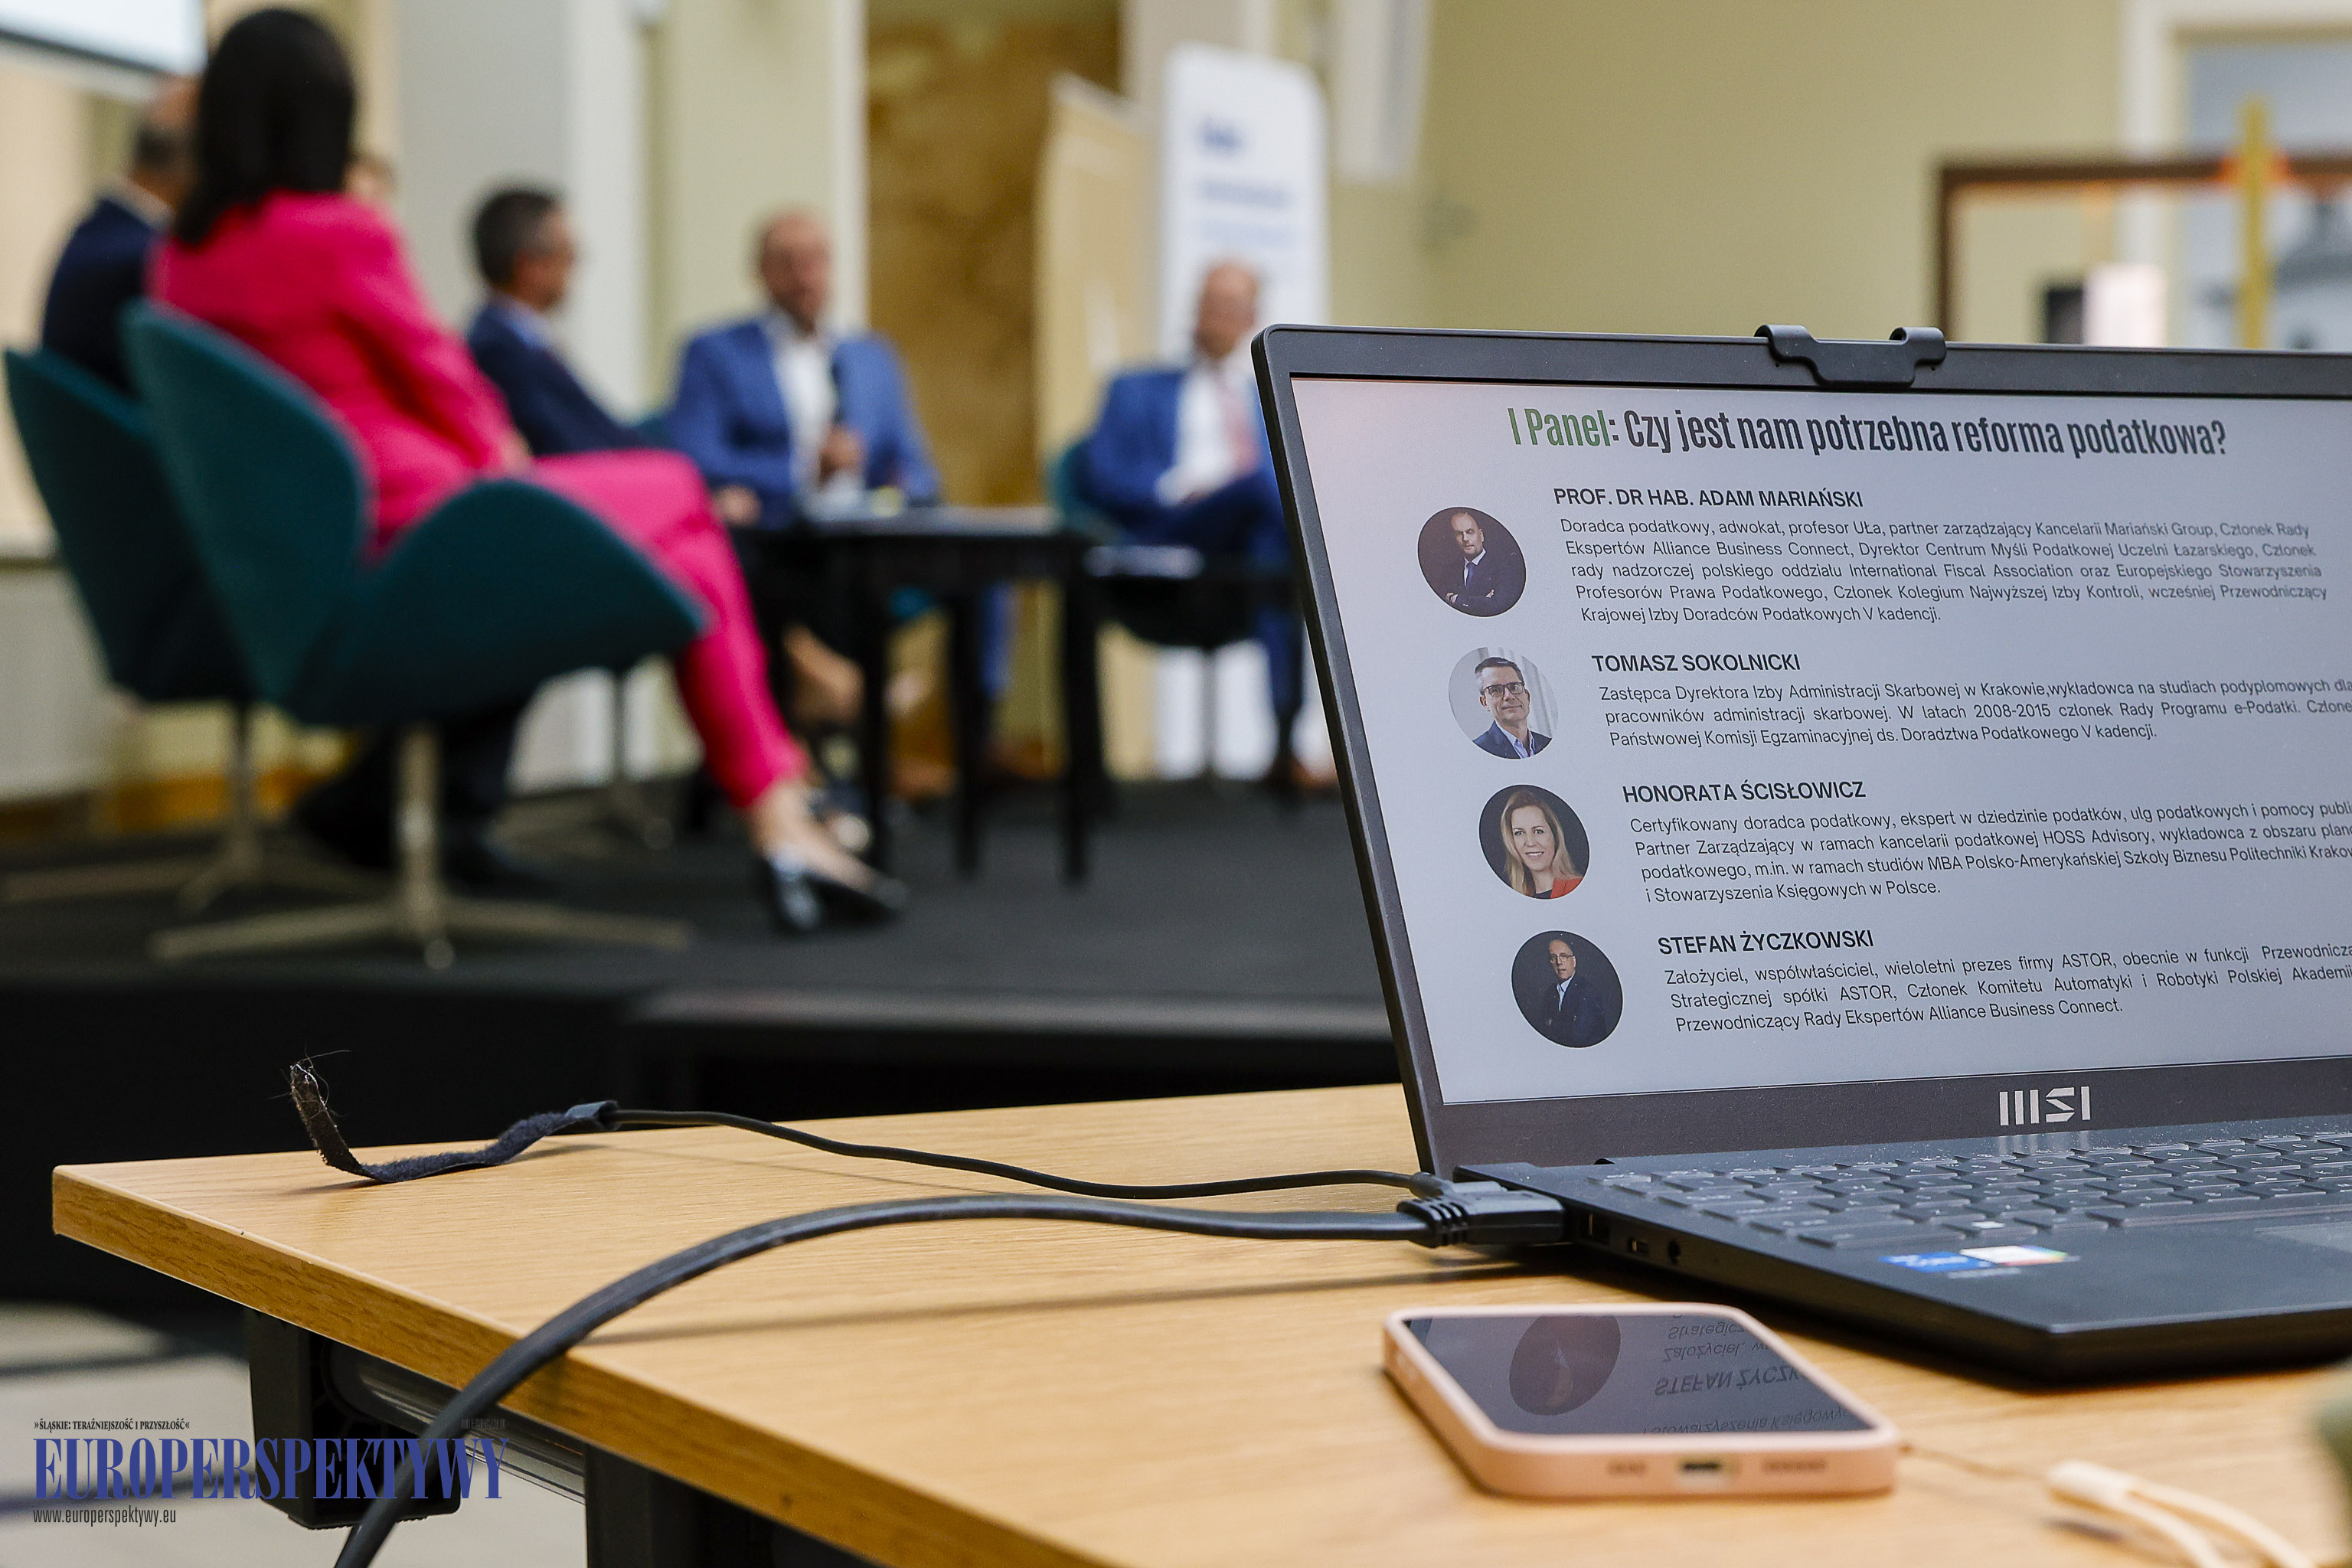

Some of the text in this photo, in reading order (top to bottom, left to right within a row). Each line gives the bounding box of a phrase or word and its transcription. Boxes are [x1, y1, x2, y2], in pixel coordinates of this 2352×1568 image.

[1524, 408, 1619, 446] Panel:
[1624, 410, 1671, 453] Czy
[1674, 410, 1736, 452] jest
[1736, 418, 1804, 449] nam
[1806, 414, 1949, 456] potrzebna
[1951, 417, 2064, 453] reforma
[2066, 419, 2226, 459] podatkowa?
[1553, 487, 1863, 507] PROF. DR HAB. ADAM MARIAŃSKI
[1560, 518, 2168, 537] Doradca podatkowy, adwokat, profesor UŁa, partner zarządzający Kancelarii Mariański
[1566, 541, 2258, 559] Ekspertów Alliance Business Connect, Dyrektor Centrum Myśli Podatkowej Uczelni Łazarskiego,
[1571, 563, 2321, 580] rady nadzorczej polskiego oddziału International Fiscal Association oraz Europejskiego Stowarzyszenia
[1576, 584, 2326, 602] Profesorów Prawa Podatkowego, Członek Kolegium Najwyższej Izby Kontroli, wcześniej Przewodniczący
[1581, 606, 1941, 624] Krajowej Izby Doradców Podatkowych kadencji.
[1591, 654, 1800, 671] TOMASZ SOKOLNICKI
[1599, 679, 2331, 703] Zastępca Dyrektora Izby Administracji Skarbowej na studiach podyplomowych
[1606, 700, 2301, 726] pracowników administracji skarbowej. W latach 2008-2015 członek Rady Programu e-Podatki.
[1610, 724, 2157, 747] Państwowej Komisji Egzaminacyjnej ds. Doradztwa Podatkowego kadencji.
[1622, 779, 1866, 802] HONORATA ŚCISŁOWICZ
[1630, 804, 2314, 835] Certyfikowany doradca podatkowy, ekspert dziedzinie podatków, ulg podatkowych pomocy
[1635, 825, 2316, 857] Partner Zarządzający ramach kancelarii podatkowej HOSS Advisory, wykładowca obszaru
[1642, 845, 2307, 883] podatkowego, m.in. ramach studiów MBA Polsko-Amerykańskiej Szkoły Biznesu Politechniki
[1655, 880, 1940, 903] Stowarzyszenia Księgowych Polsce.
[1658, 929, 1873, 954] STEFAN ŻYCZKOWSKI
[1664, 946, 2249, 986] Założyciel, współwłaściciel, wieloletni prezes firmy ASTOR, obecnie funkcji
[1671, 968, 2282, 1009] Strategicznej spółki ASTOR, Członek Komitetu Automatyki Robotyki Polskiej
[1676, 998, 2122, 1031] Przewodniczący Rady Ekspertów Alliance Business Connect.
[2000, 1086, 2091, 1126] MSI
